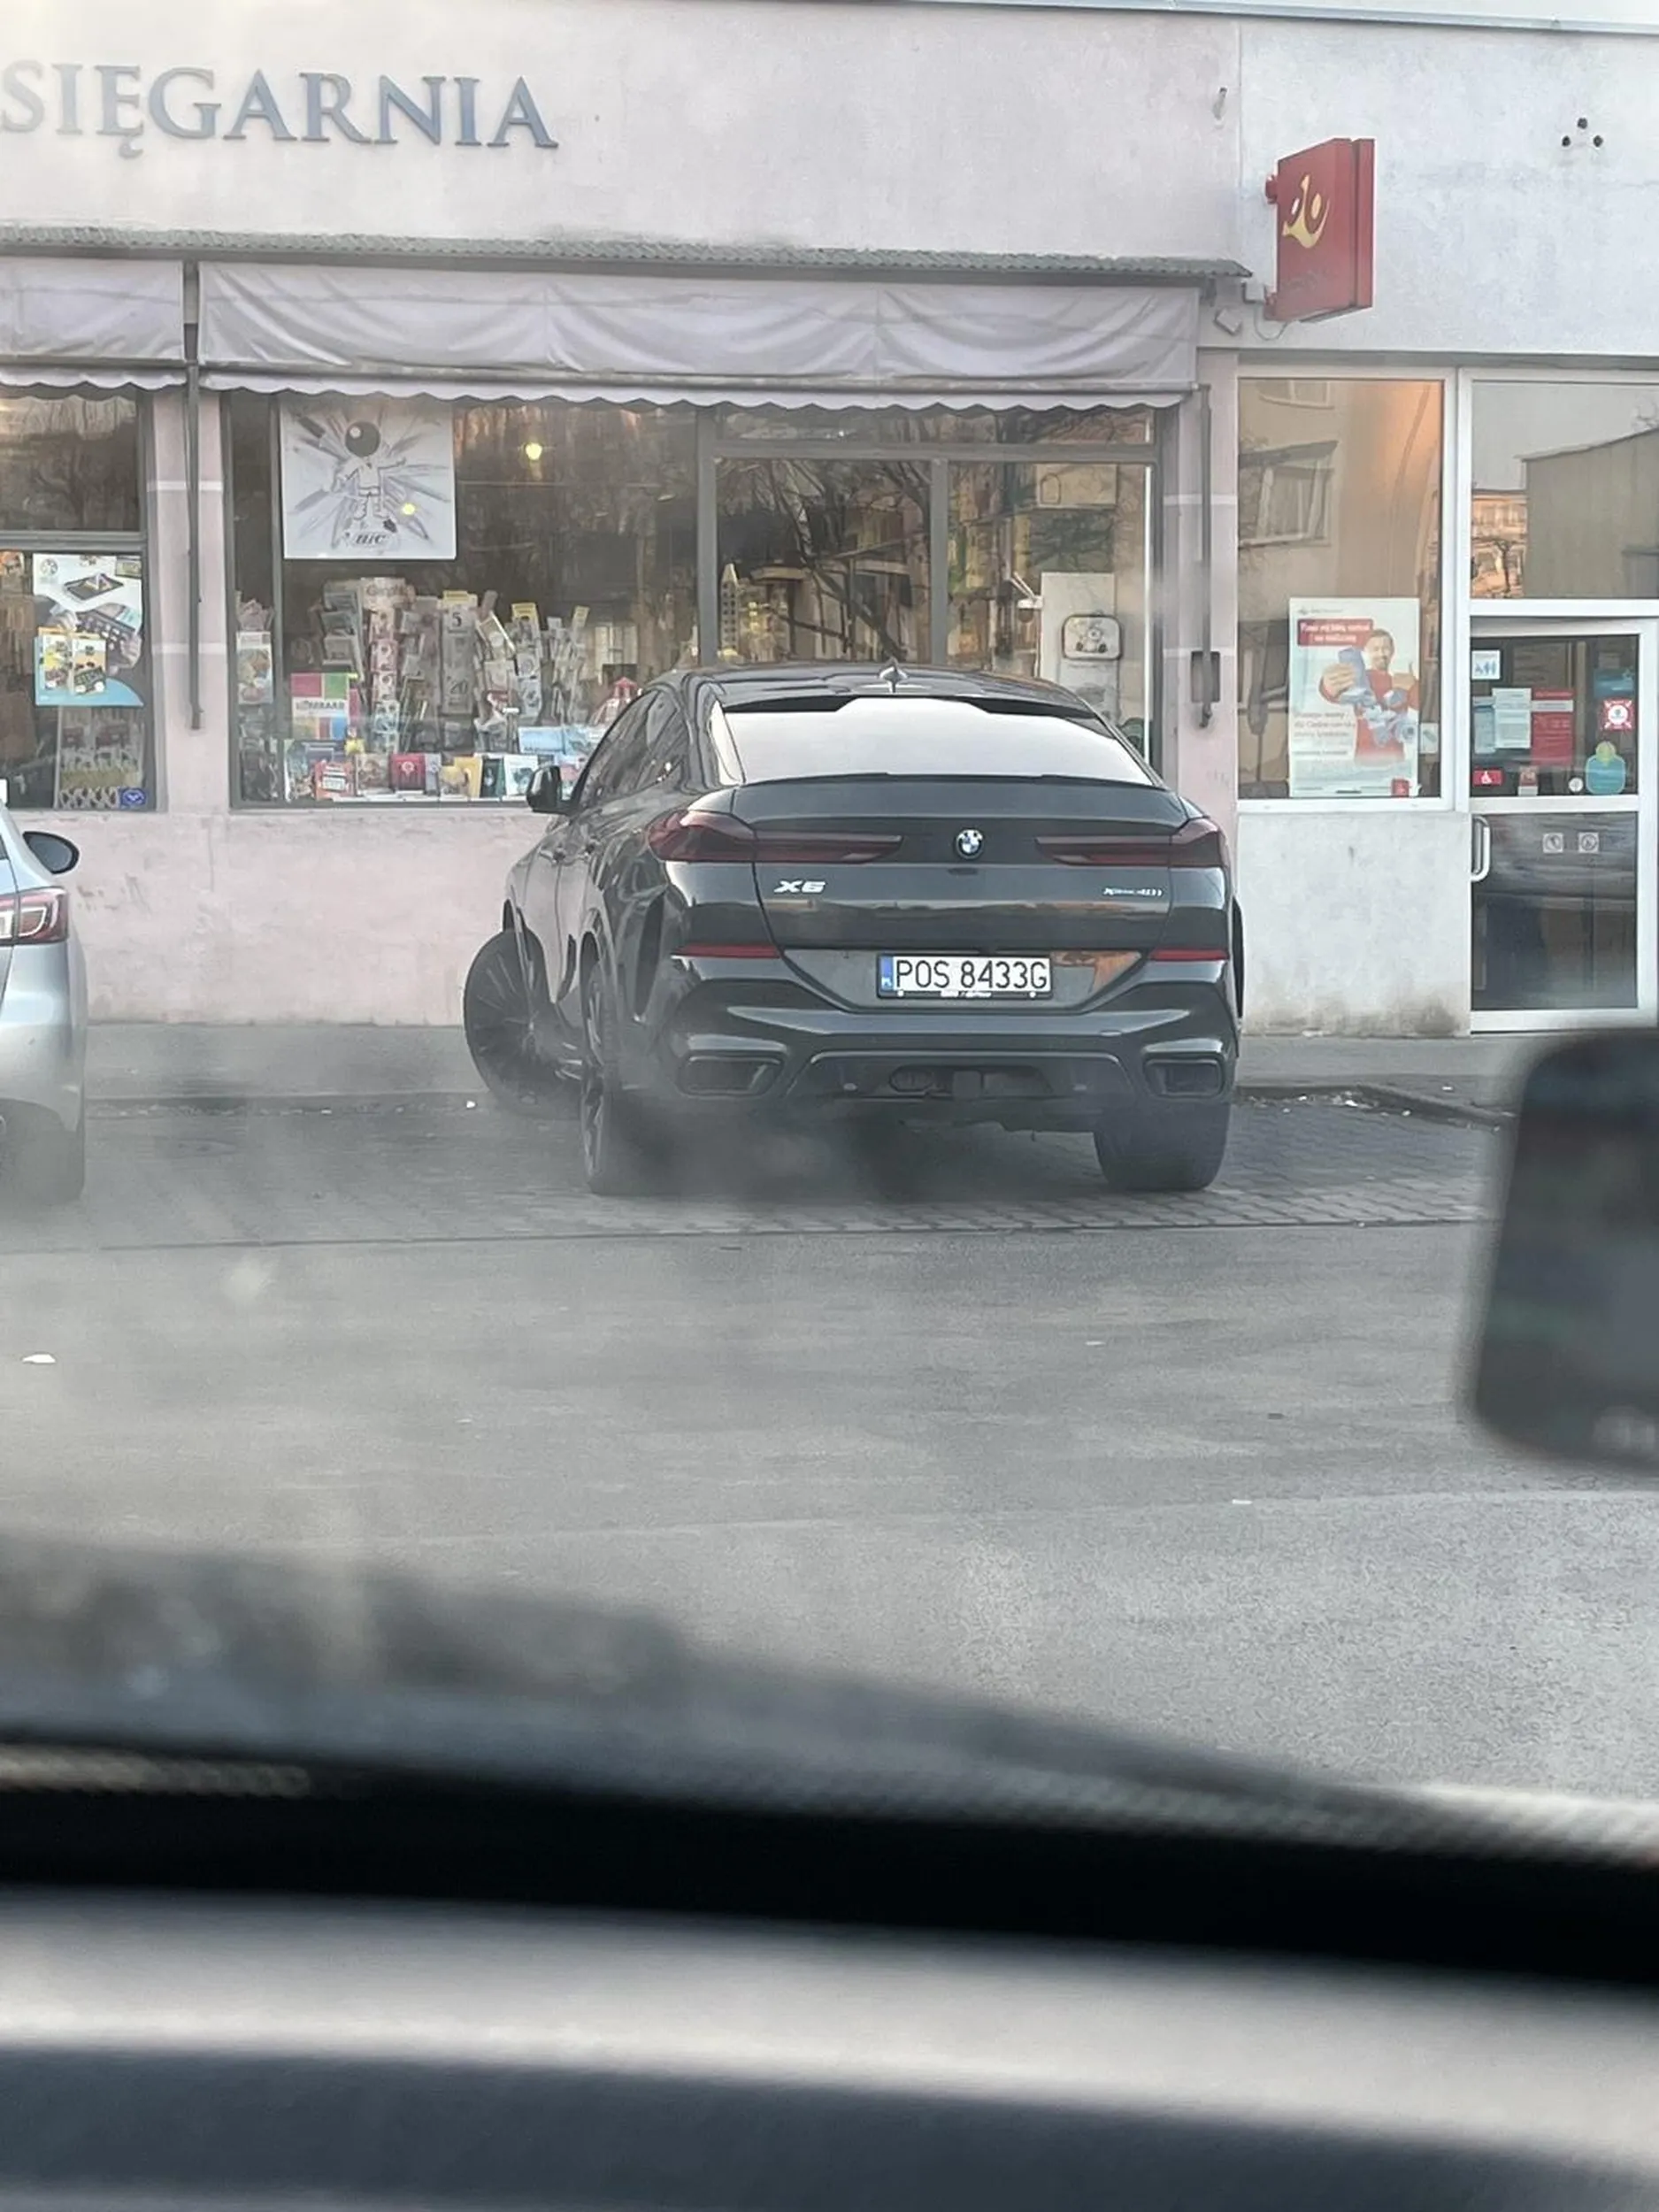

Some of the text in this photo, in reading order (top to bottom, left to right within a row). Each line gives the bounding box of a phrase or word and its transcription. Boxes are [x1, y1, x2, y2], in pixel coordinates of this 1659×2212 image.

[0, 59, 559, 158] SIĘGARNIA
[774, 879, 826, 893] X6
[895, 959, 1047, 989] POS 8433G
